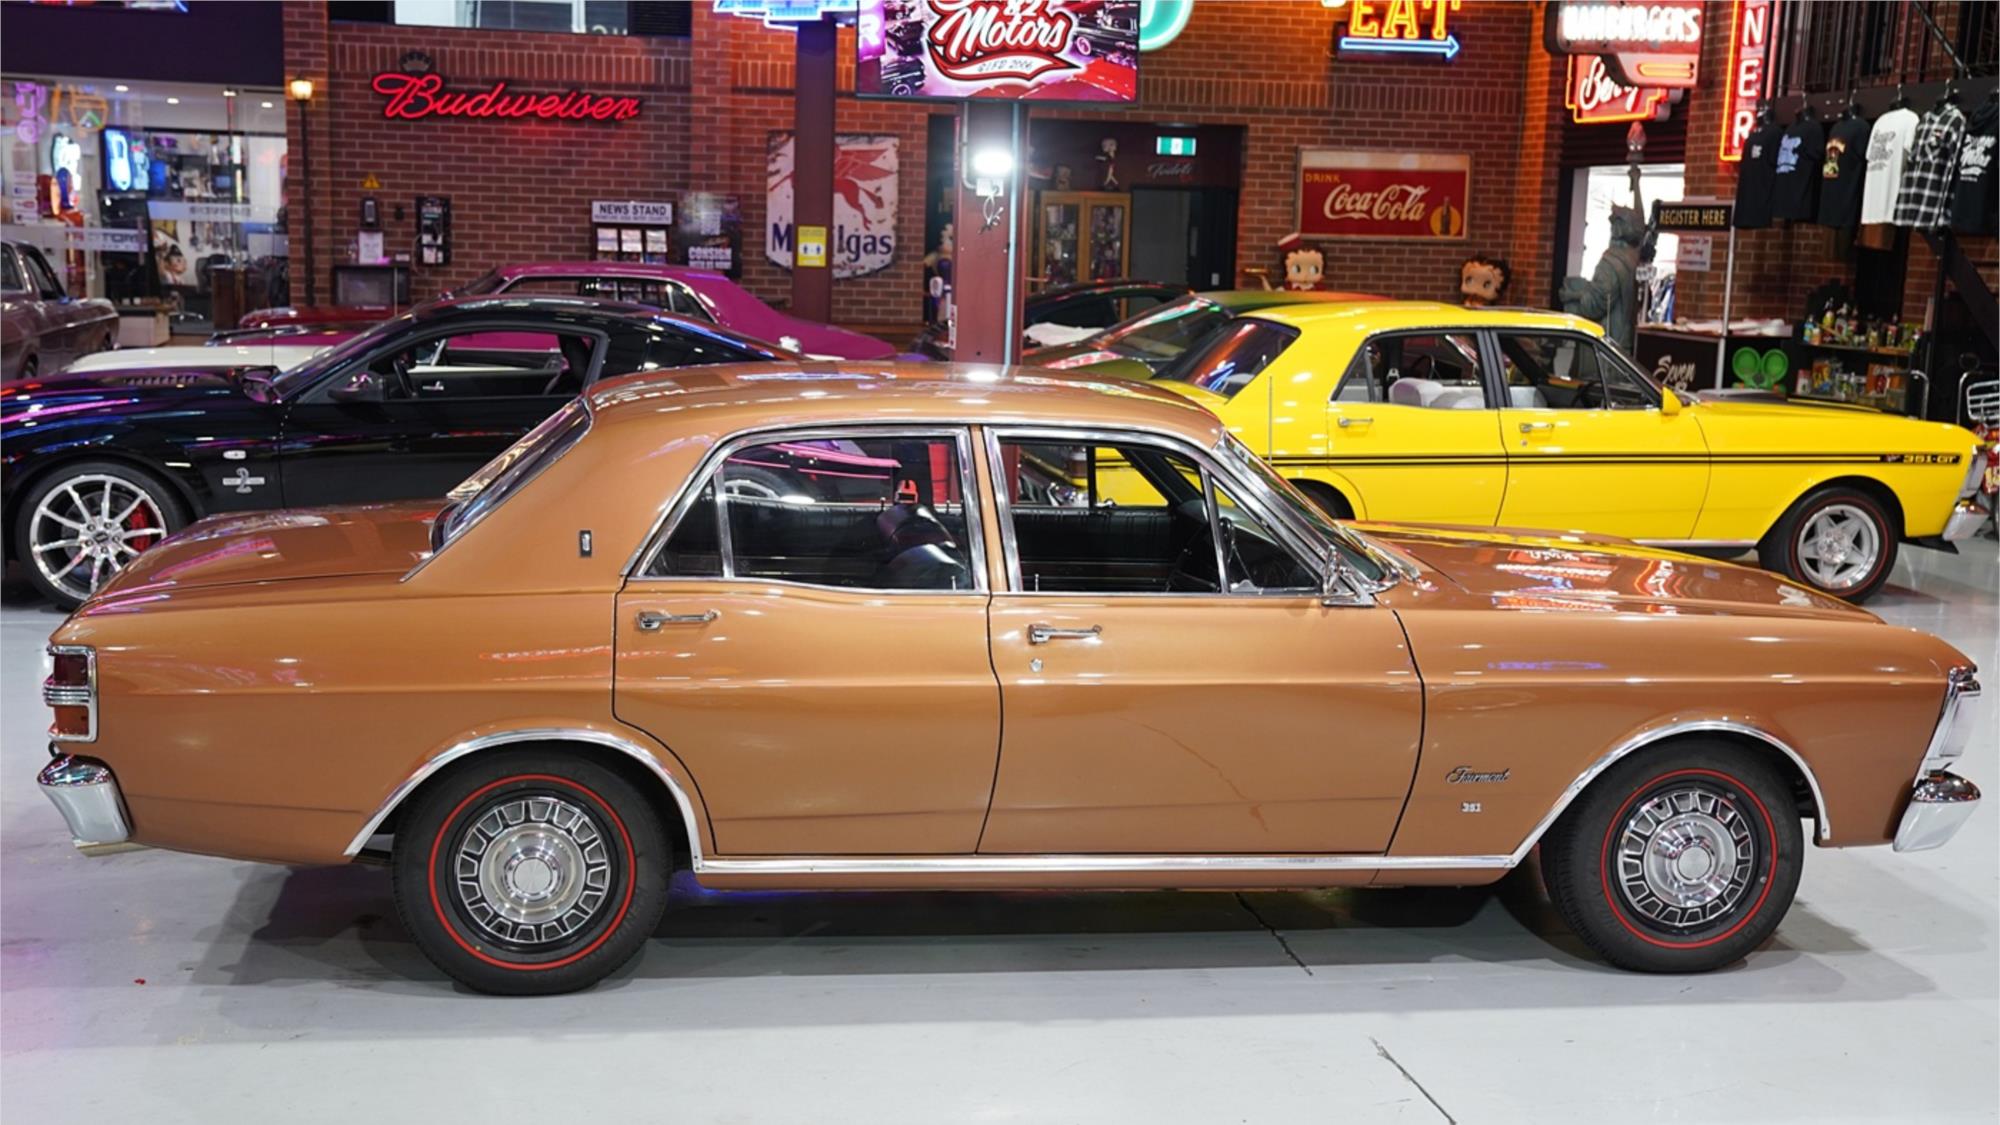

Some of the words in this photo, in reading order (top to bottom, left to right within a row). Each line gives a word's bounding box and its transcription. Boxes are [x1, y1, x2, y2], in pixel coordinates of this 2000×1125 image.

[935, 5, 1067, 59] Motors
[1350, 0, 1461, 40] EAT
[1563, 5, 1701, 42] HAMBURGERS
[372, 73, 641, 120] Budweiser
[1305, 173, 1340, 183] DRINK
[600, 204, 629, 215] NEWS
[633, 205, 667, 216] STAND
[1323, 183, 1431, 221] Coca-Cola
[1660, 209, 1700, 226] REGISTER
[1702, 209, 1726, 226] HERE
[771, 222, 893, 262] Mlgas
[1445, 765, 1511, 784] Fairmont
[1461, 802, 1482, 813] 351
